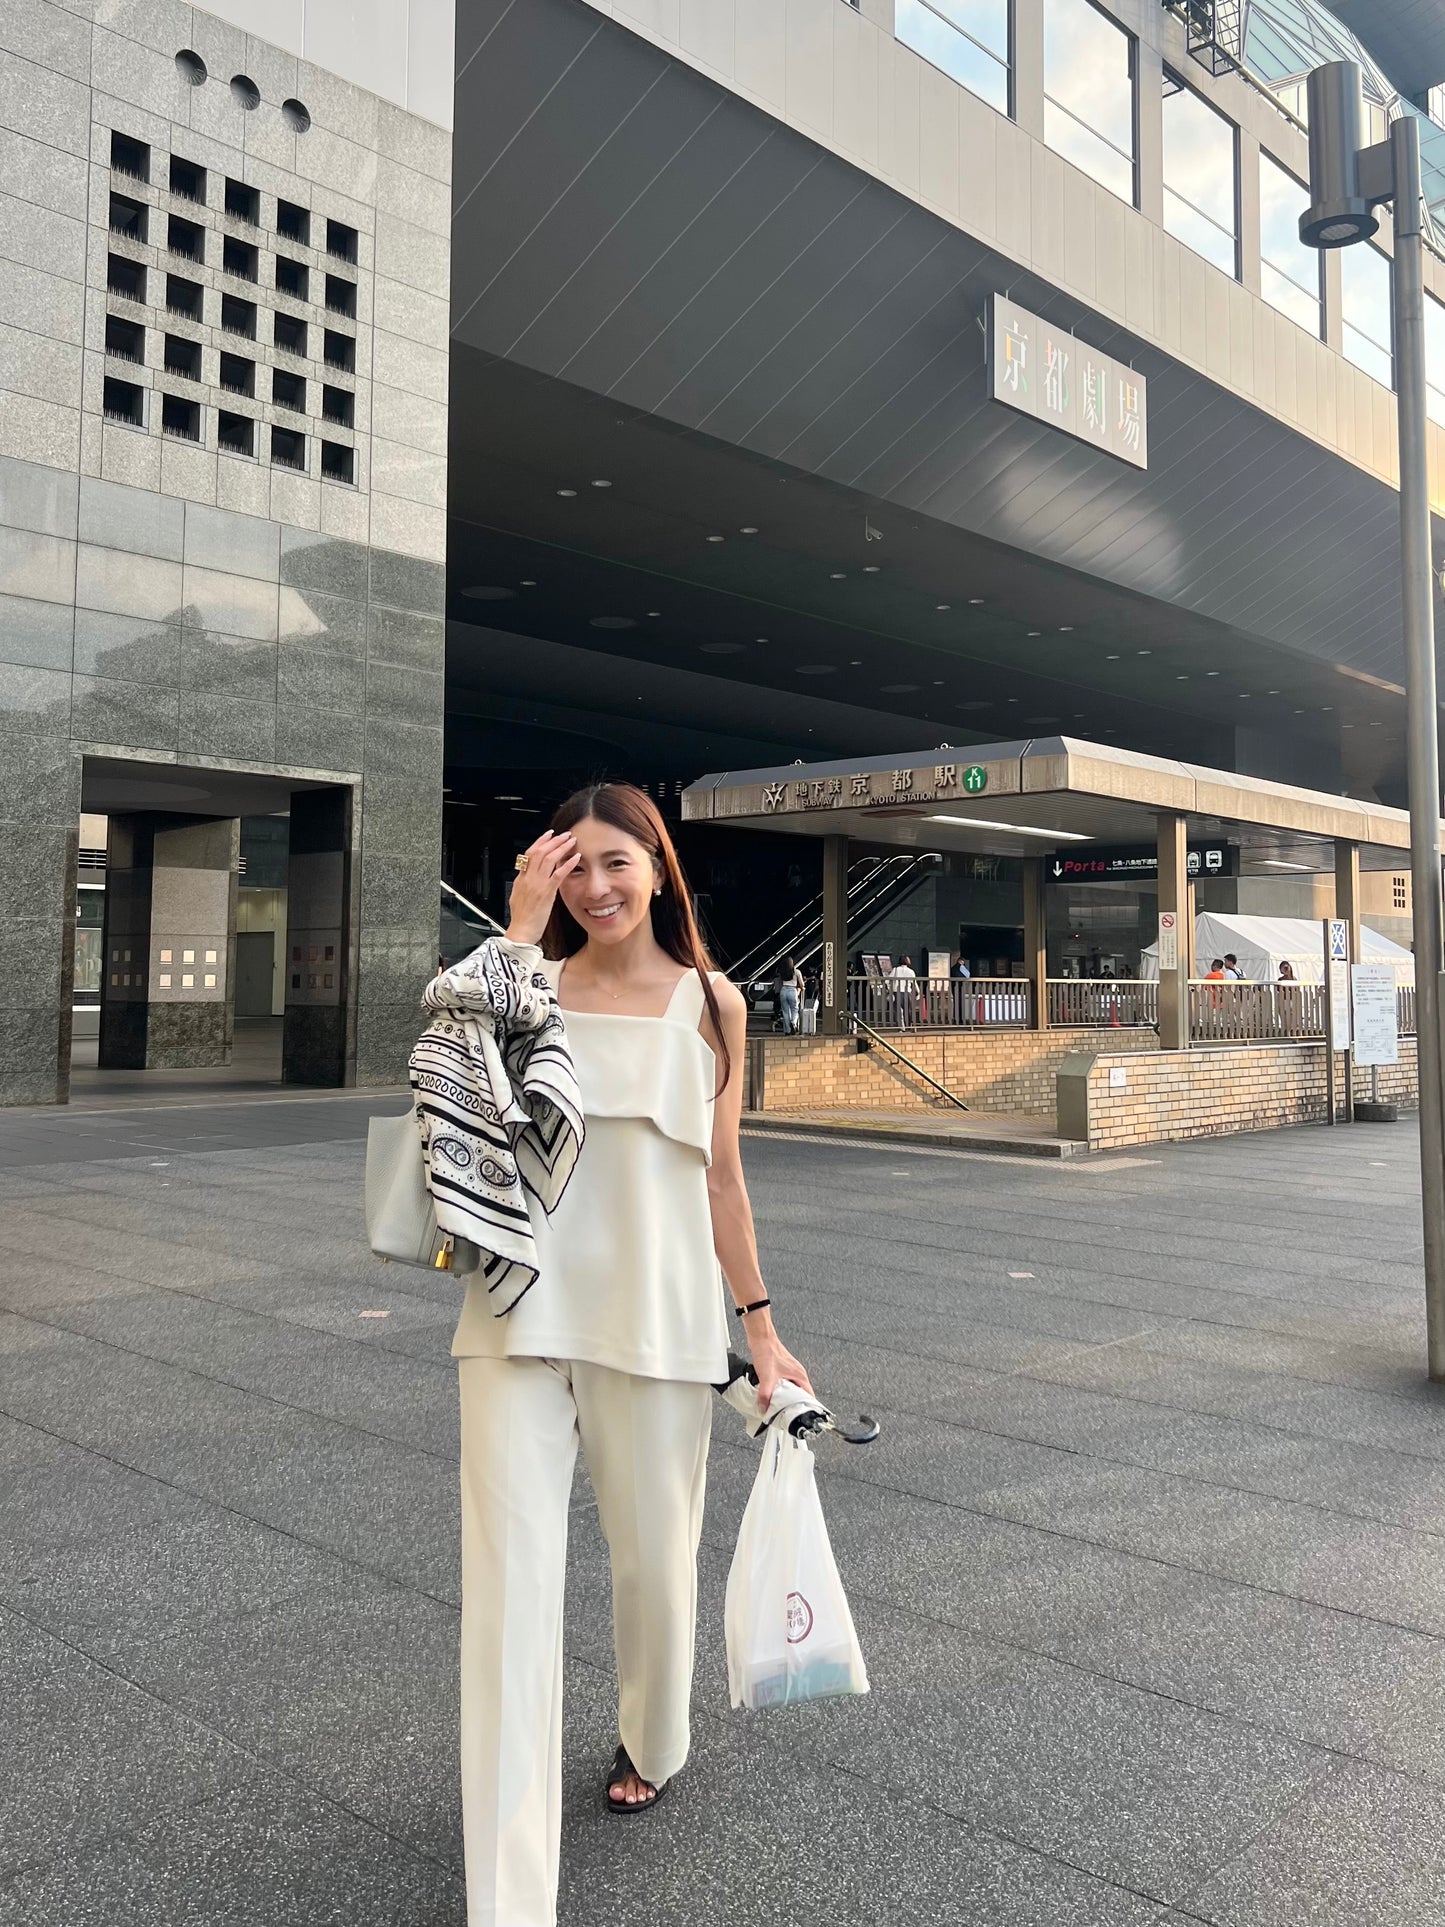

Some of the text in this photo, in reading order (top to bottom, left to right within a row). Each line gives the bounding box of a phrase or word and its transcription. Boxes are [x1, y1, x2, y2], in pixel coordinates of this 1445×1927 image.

[1003, 319, 1140, 451] 京都劇場
[971, 767, 979, 776] K
[795, 764, 956, 797] 地下鉄 京都駅
[967, 775, 981, 789] 11
[802, 791, 936, 808] SUBWAY KYOTO STATION
[1063, 860, 1105, 873] Porta
